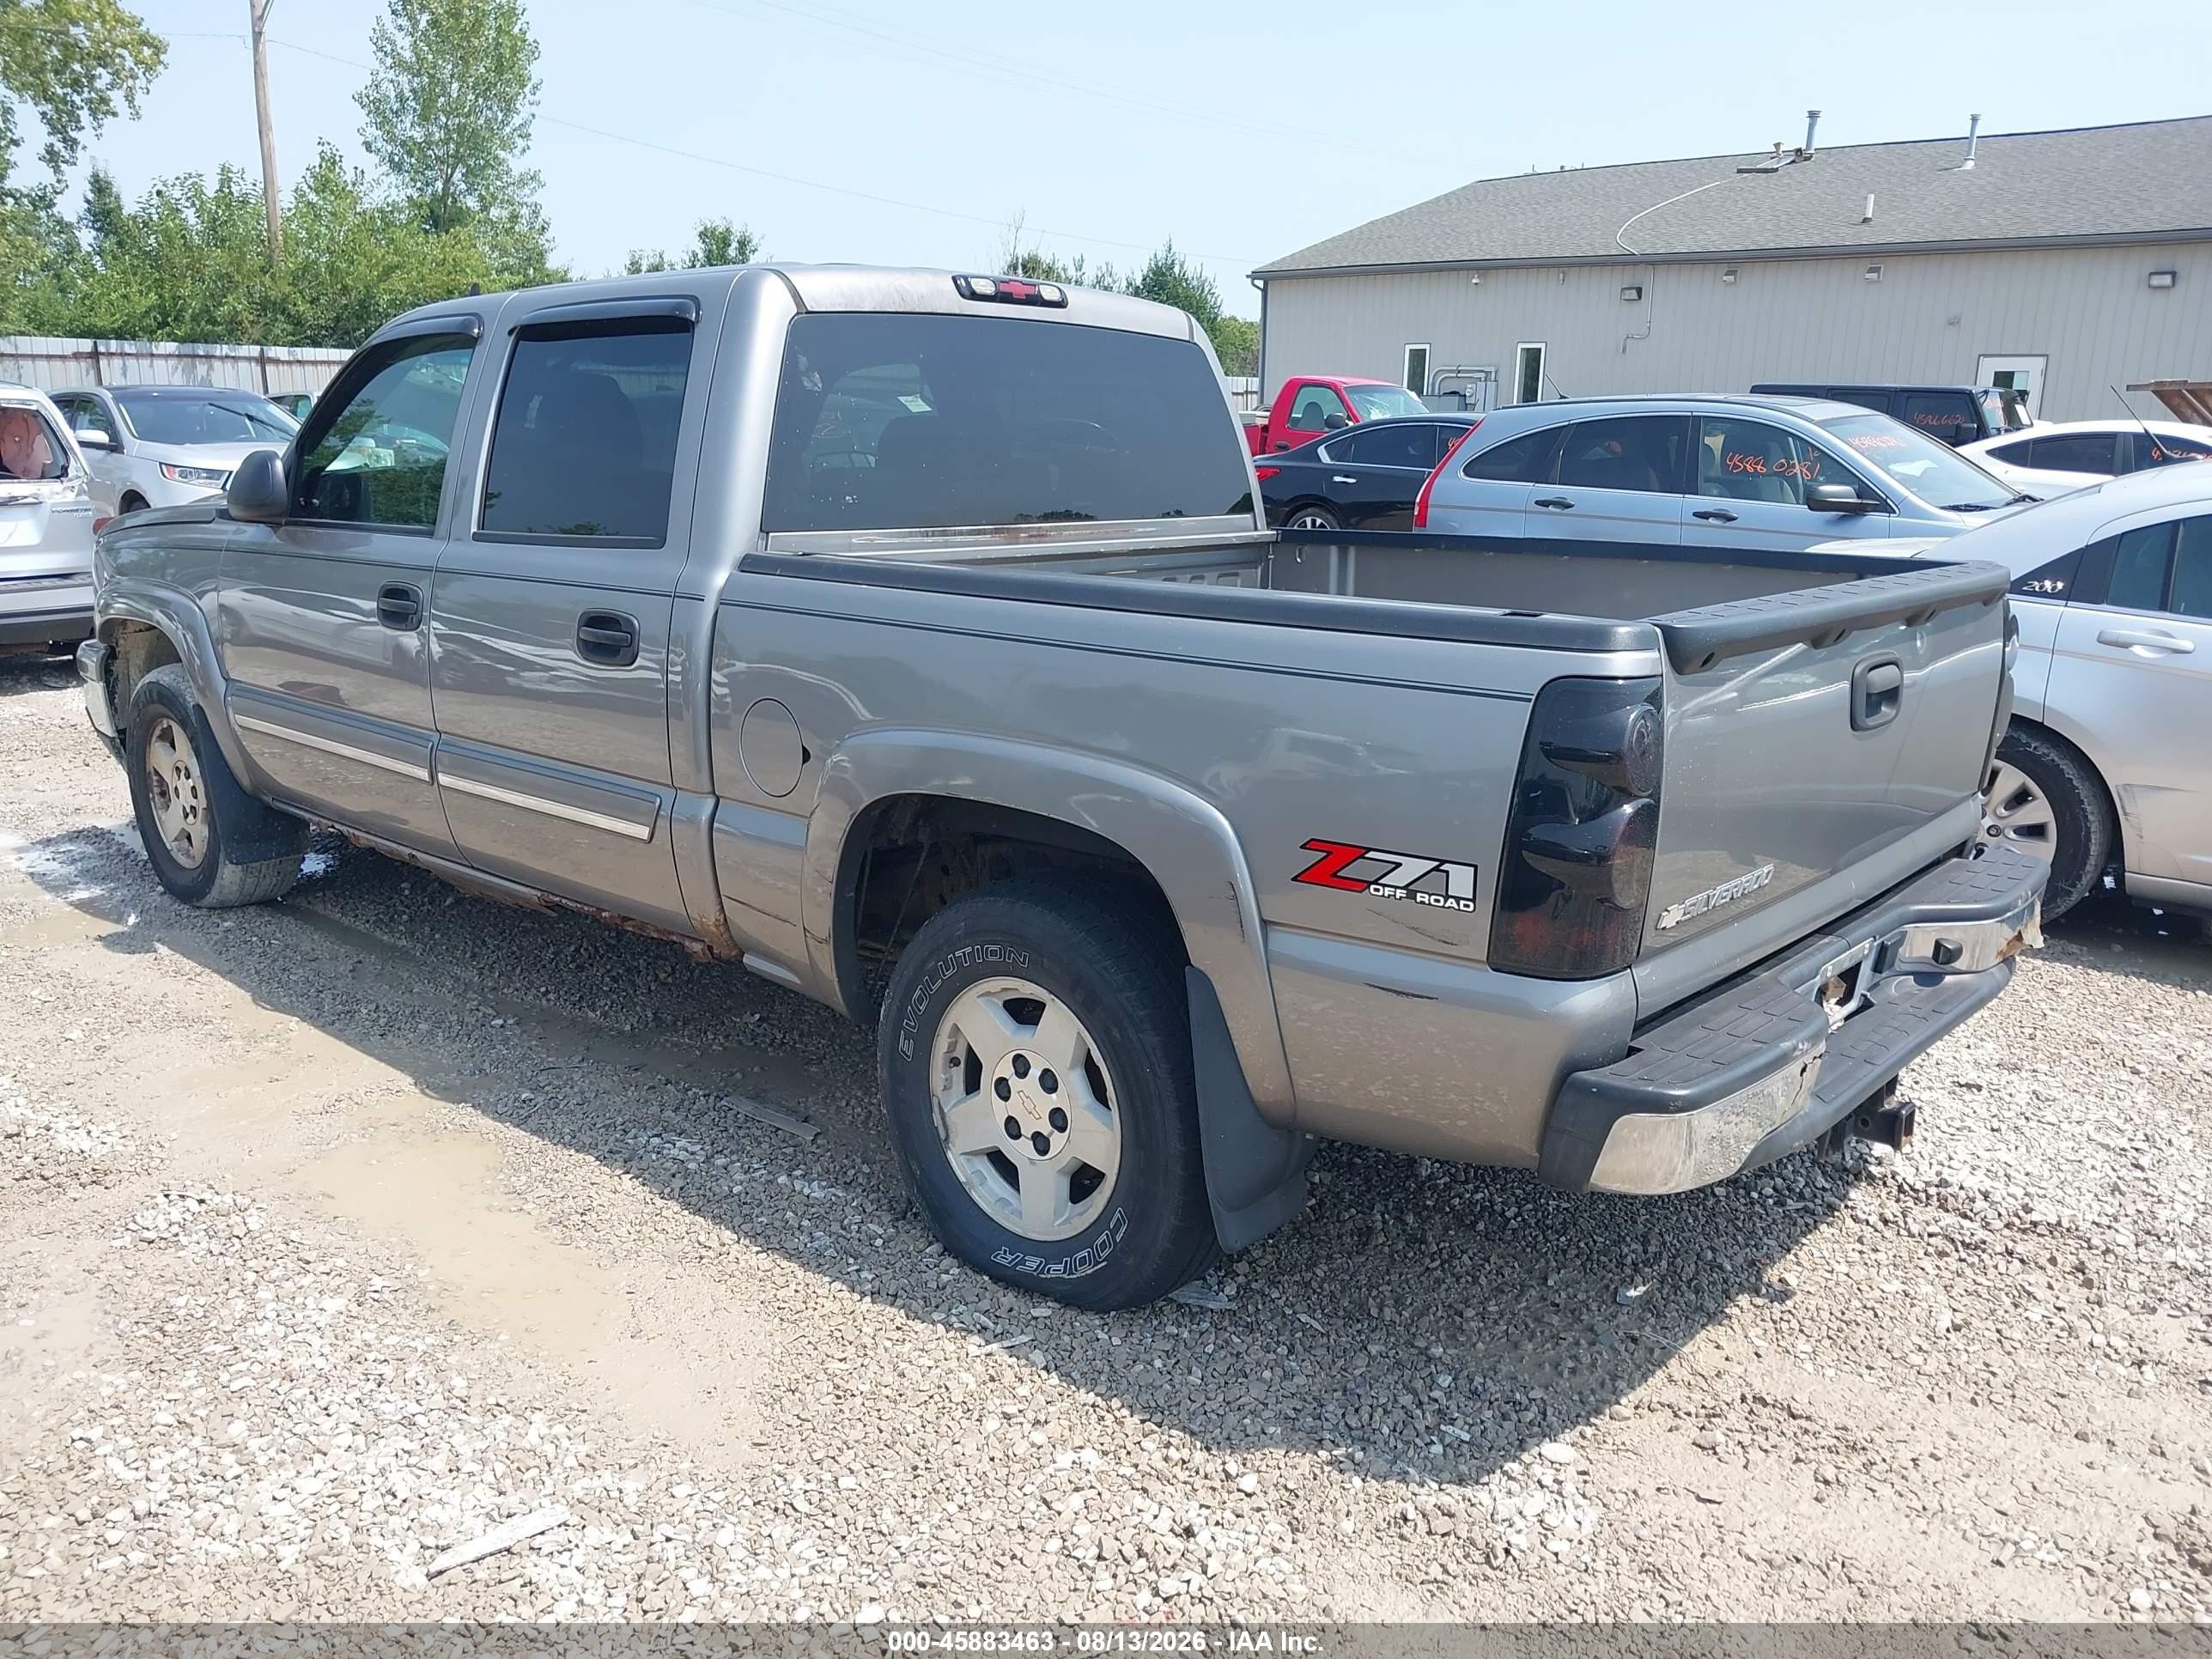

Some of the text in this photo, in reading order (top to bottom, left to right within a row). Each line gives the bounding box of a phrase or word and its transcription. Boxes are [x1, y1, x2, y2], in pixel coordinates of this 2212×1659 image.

[2021, 579, 2064, 593] 200
[1291, 837, 1479, 900] Z71
[1369, 884, 1475, 913] OFF ROAD
[1681, 863, 1775, 922] SILVERADO
[899, 945, 1030, 1061] EVOLUTION
[990, 1206, 1129, 1275] COOPER
